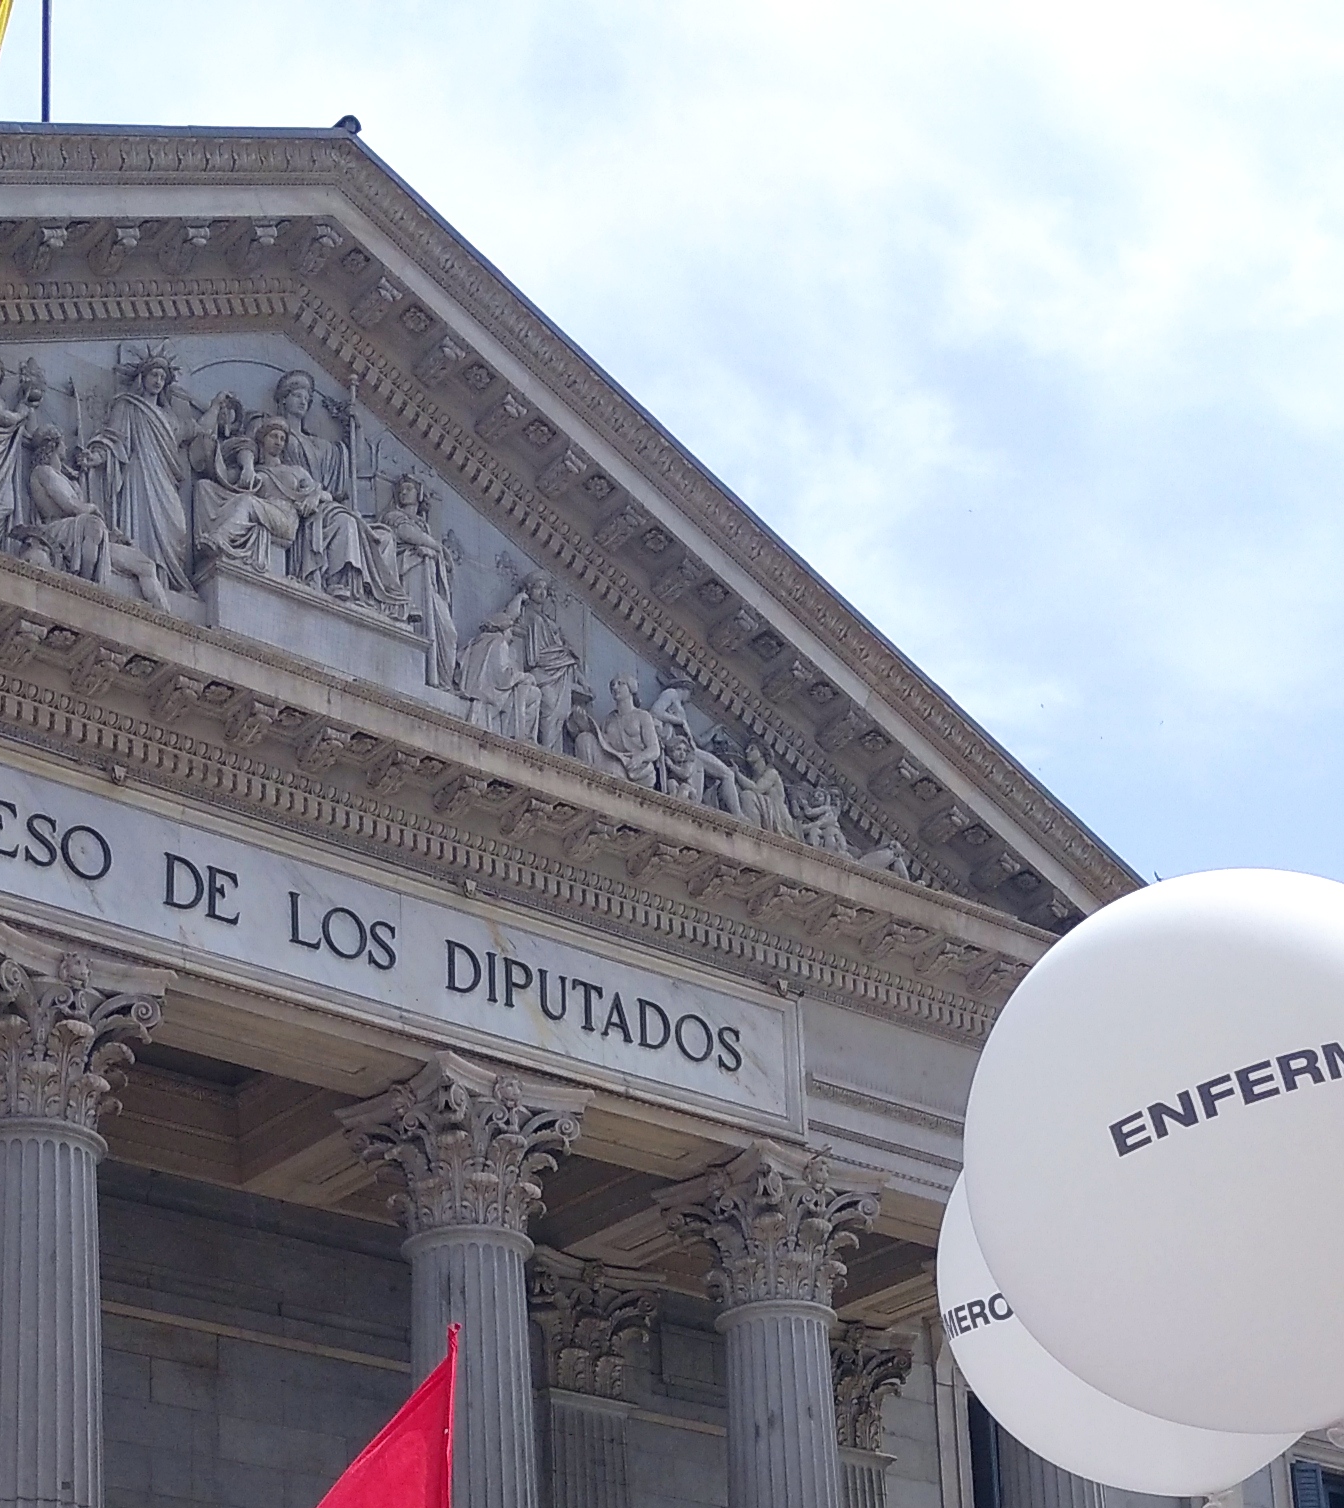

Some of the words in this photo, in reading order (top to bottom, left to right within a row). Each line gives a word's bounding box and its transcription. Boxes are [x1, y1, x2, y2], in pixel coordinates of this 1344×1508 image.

[163, 851, 240, 926] DE
[289, 890, 398, 971] LOS
[446, 939, 743, 1074] DIPUTADOS
